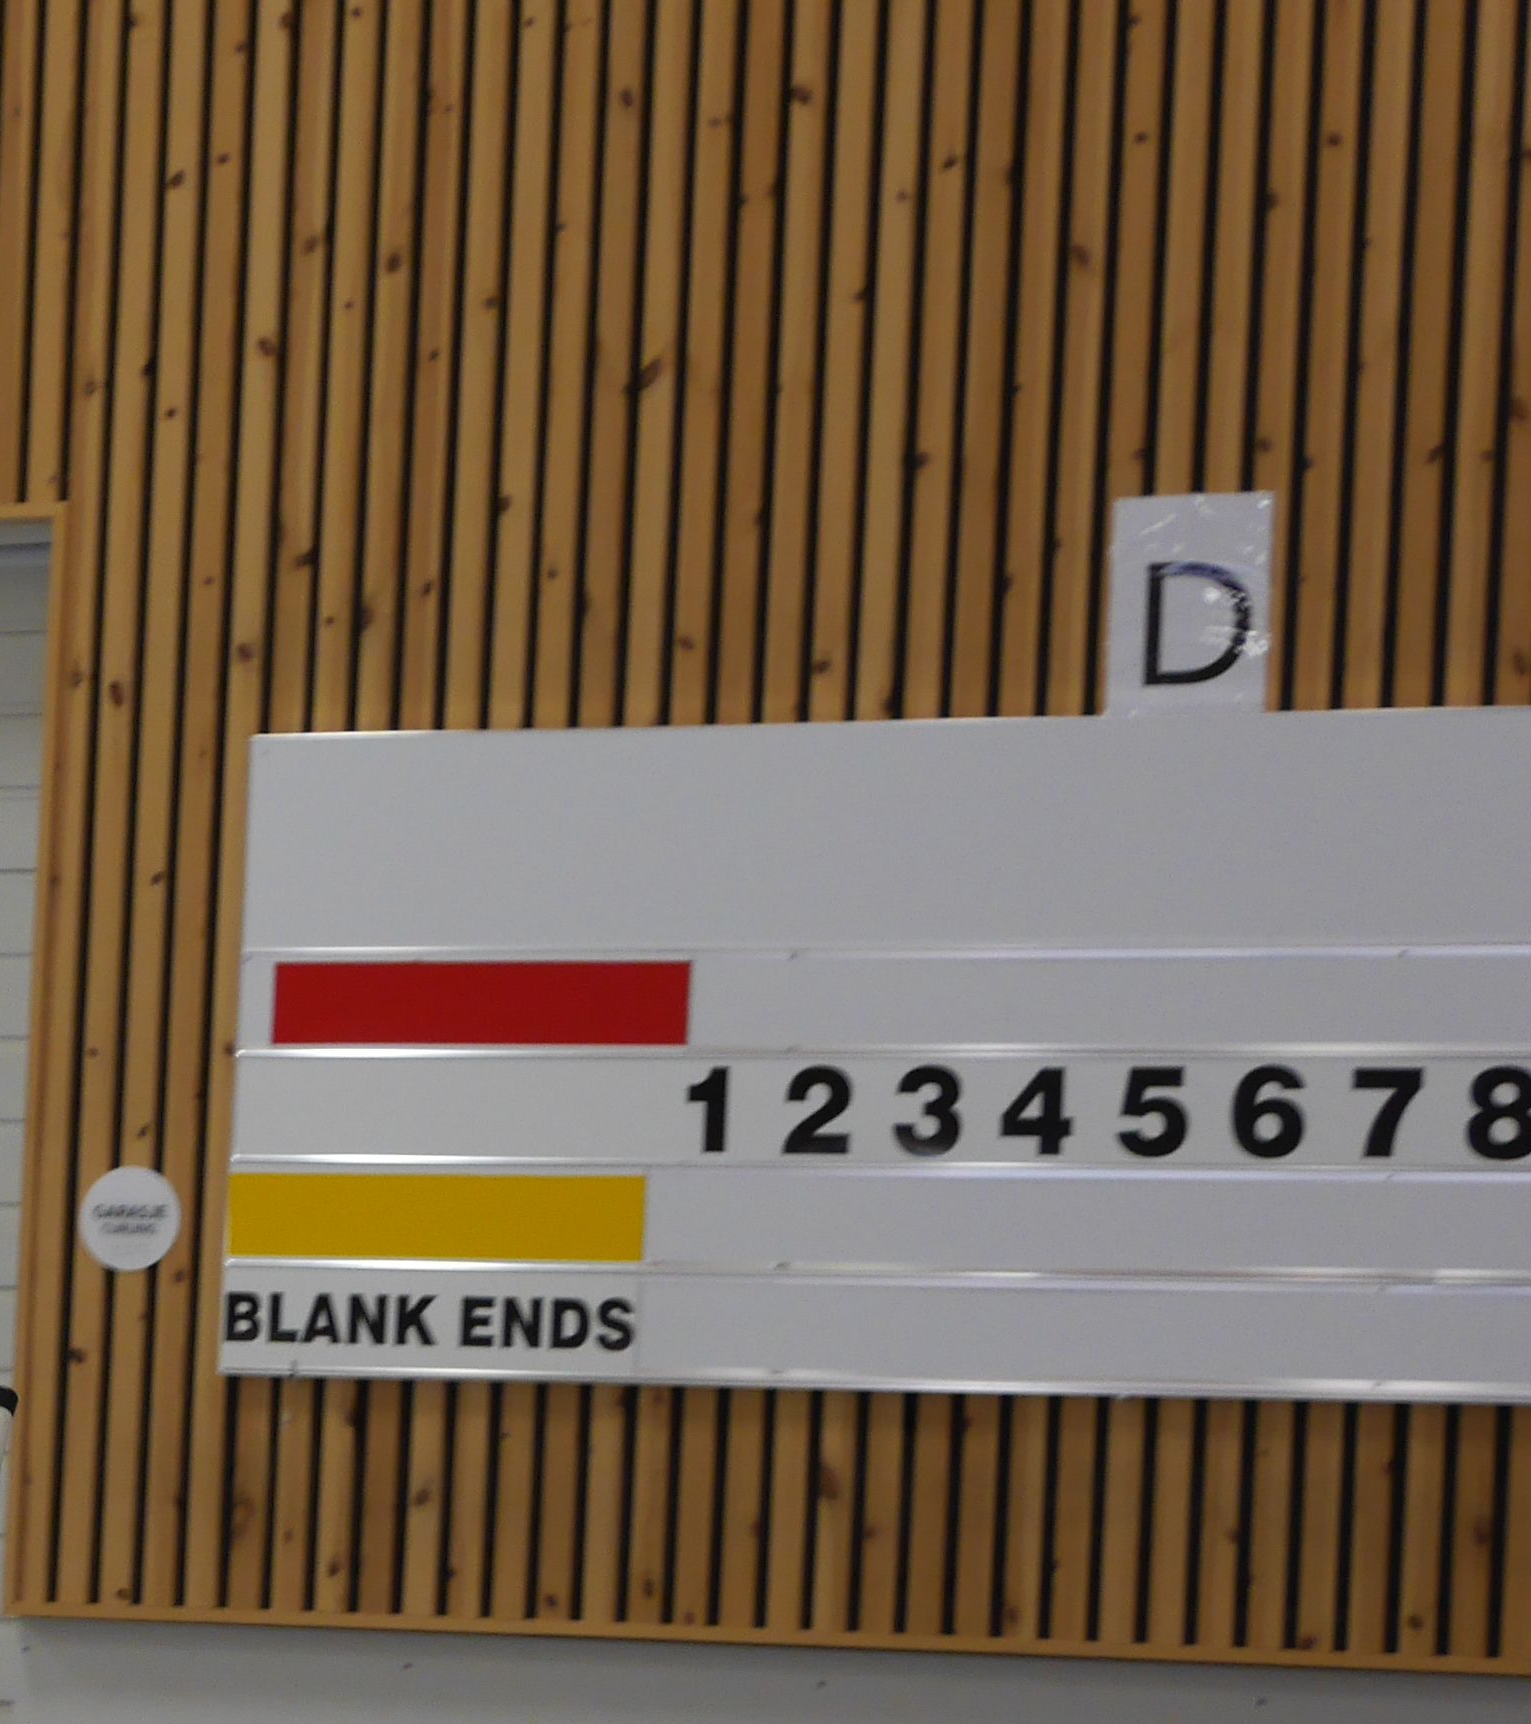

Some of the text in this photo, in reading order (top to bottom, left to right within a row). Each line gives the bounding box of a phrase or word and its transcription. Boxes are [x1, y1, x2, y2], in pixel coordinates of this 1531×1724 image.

[1143, 559, 1255, 688] D
[686, 1064, 1531, 1160] 1 2 3 4 5 6 7 8
[222, 1291, 637, 1352] BLANK ENDS
